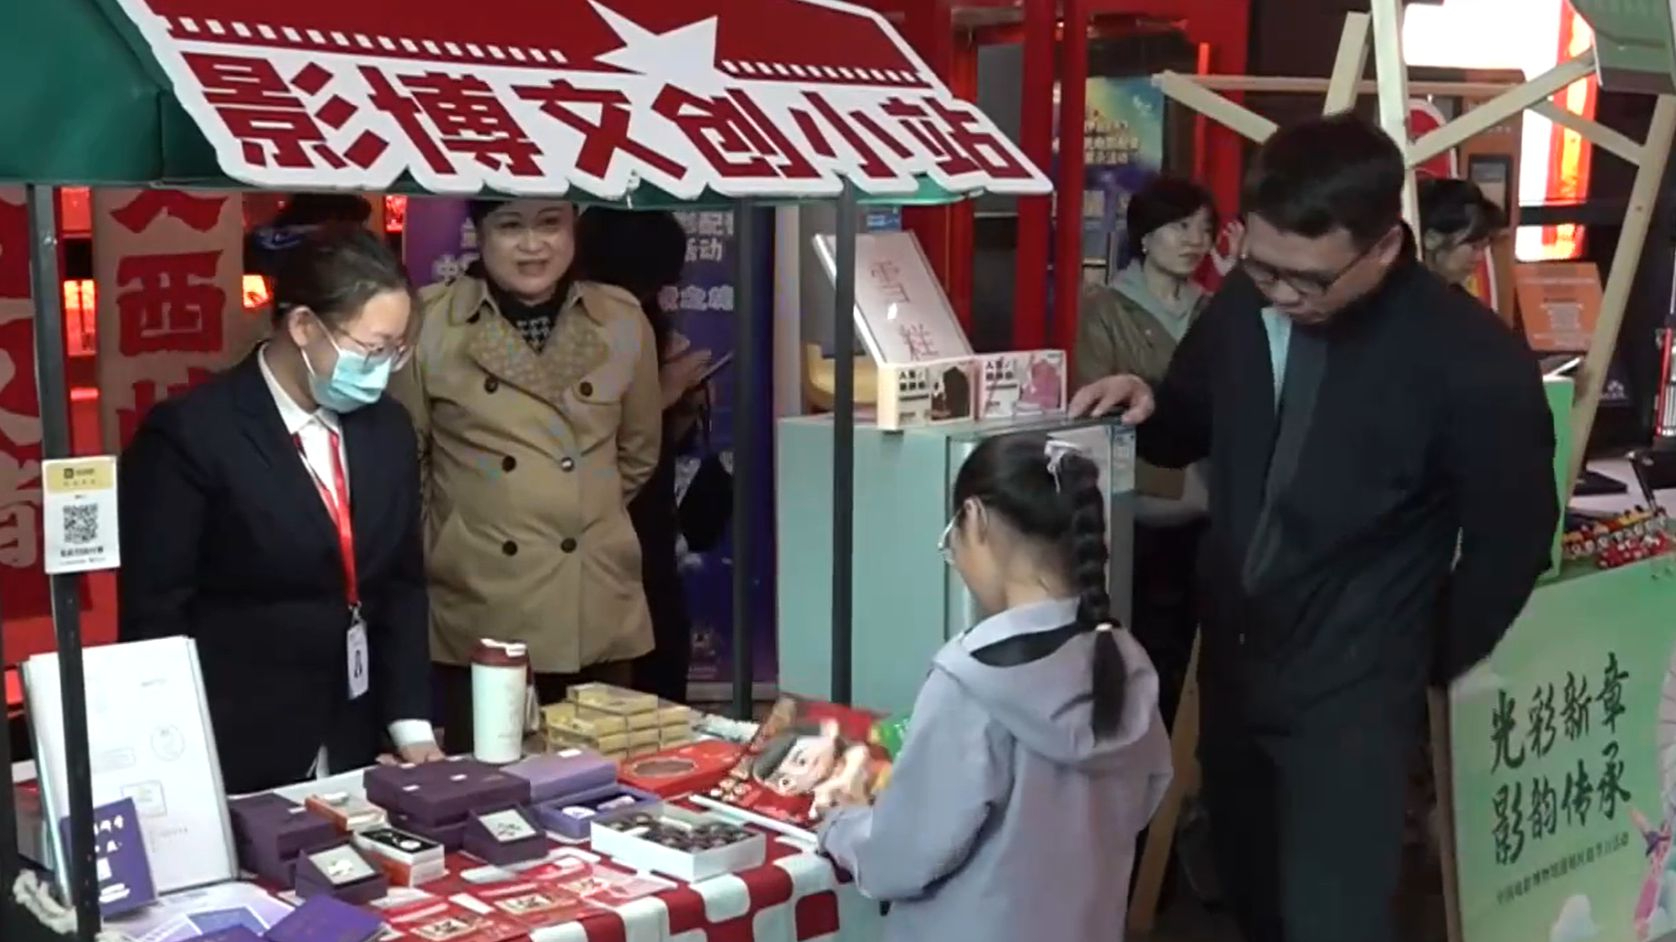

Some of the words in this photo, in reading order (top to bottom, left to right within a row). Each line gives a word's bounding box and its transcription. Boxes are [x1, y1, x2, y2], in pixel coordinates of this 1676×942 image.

[181, 51, 1033, 180] 影博文创小站
[1490, 651, 1630, 776] 光彩新章
[1491, 740, 1632, 866] 影韵传承
